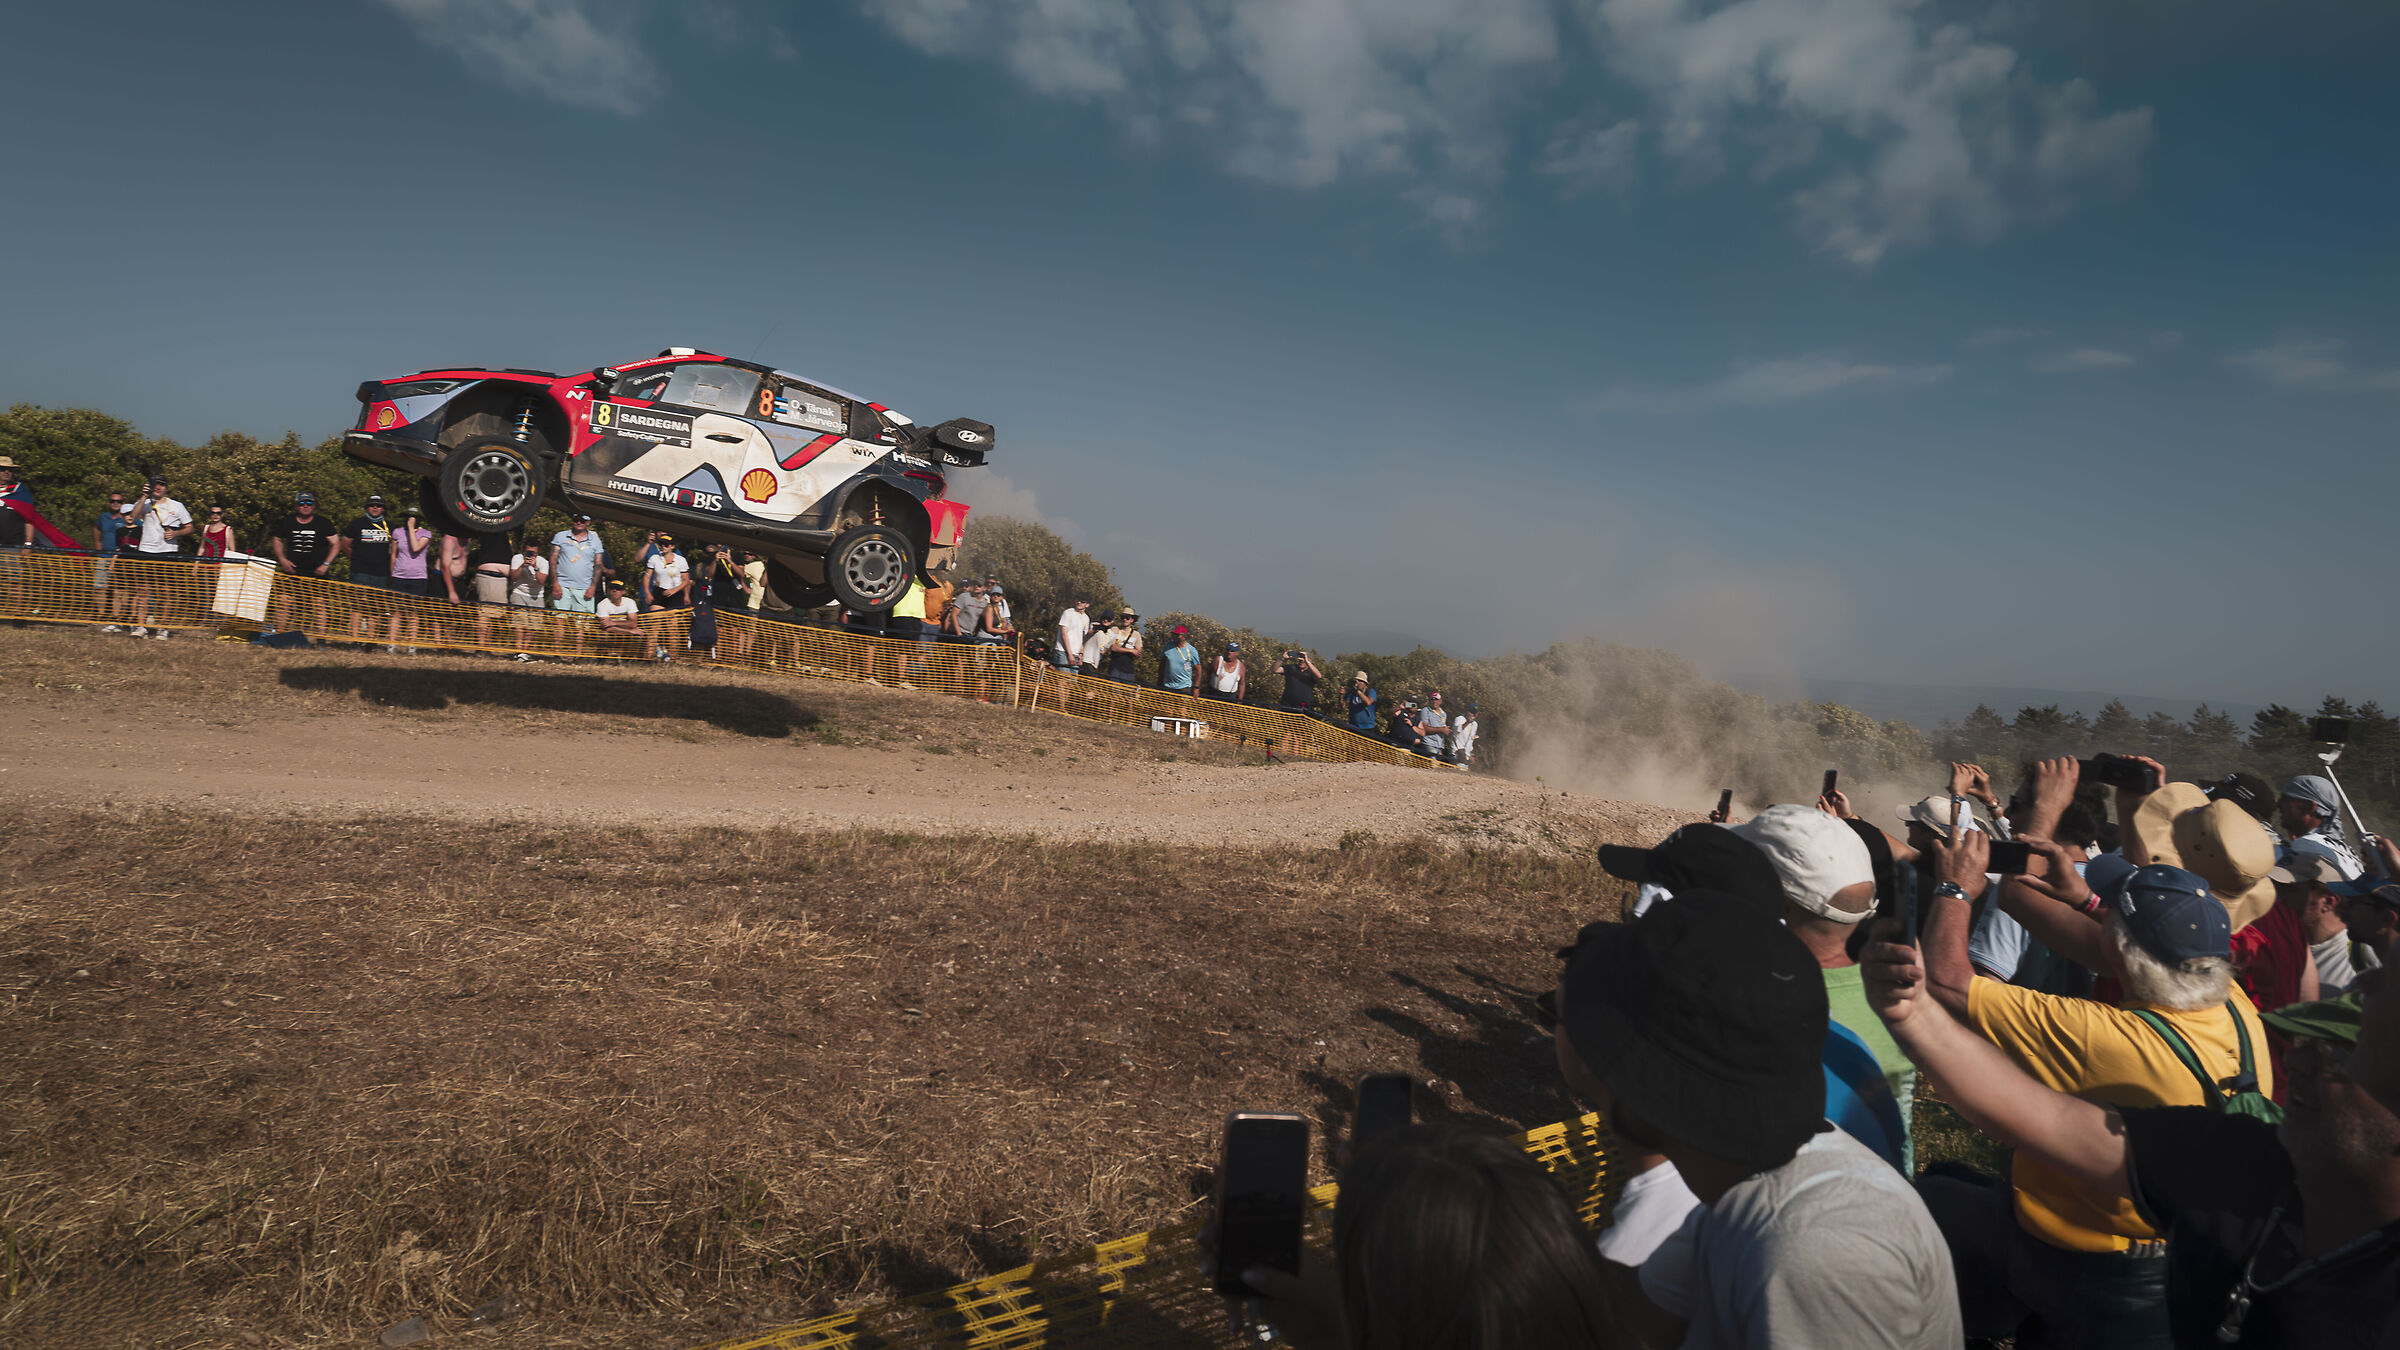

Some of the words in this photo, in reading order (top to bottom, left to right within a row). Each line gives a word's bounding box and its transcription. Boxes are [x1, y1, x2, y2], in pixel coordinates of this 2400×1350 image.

[759, 389, 775, 417] 8
[804, 402, 835, 417] Tänak
[598, 403, 611, 426] 8
[620, 413, 690, 433] SARDEGNA
[607, 480, 658, 497] HYUNDAI
[659, 485, 723, 511] MOBIS
